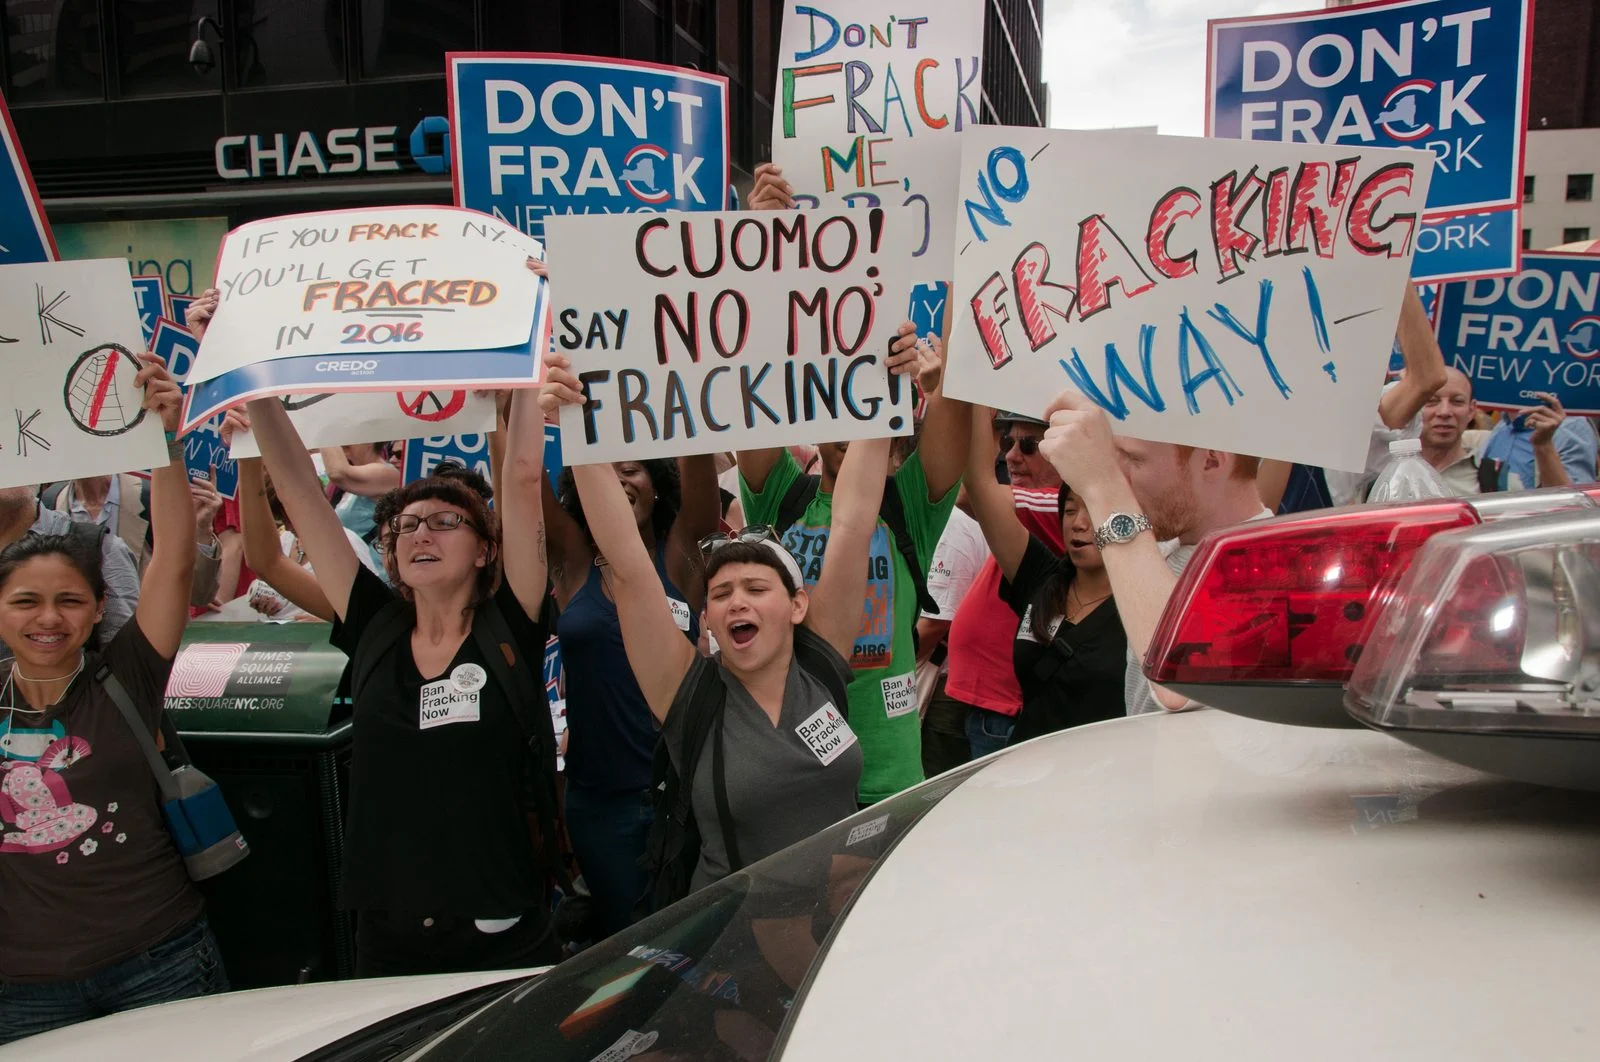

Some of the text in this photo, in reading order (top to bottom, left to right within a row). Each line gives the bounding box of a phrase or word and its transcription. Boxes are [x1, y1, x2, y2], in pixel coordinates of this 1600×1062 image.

[795, 5, 928, 61] DON'T
[1242, 7, 1491, 94] DON'T
[484, 79, 703, 145] DON'T
[782, 56, 979, 138] FRACK
[1241, 73, 1487, 145] FRACK
[215, 126, 400, 180] CHASE
[821, 135, 911, 192] ME,
[489, 144, 706, 204] FRACK
[965, 145, 1029, 243] NO
[242, 231, 279, 259] IF
[288, 227, 339, 249] YOU
[347, 222, 440, 243] FRACK
[635, 208, 885, 280] CUOMO!
[1416, 222, 1490, 253] ORK
[970, 156, 1417, 370] FRACKING
[223, 258, 428, 302] YOU'LL GET
[302, 279, 498, 312] FRACKED
[275, 321, 425, 350] IN 2016
[558, 308, 629, 351] SAY
[654, 288, 750, 365] NO
[1059, 265, 1338, 421] WAY!
[315, 360, 378, 372] CREDO
[1453, 353, 1532, 382] NEW
[578, 336, 904, 445] FRACKING!
[785, 531, 826, 556] STO
[239, 662, 293, 673] SQUARE
[252, 651, 294, 661] TIMES
[236, 675, 284, 685] ALLIANCE
[422, 685, 445, 698] Ban
[882, 680, 902, 691] Ban
[163, 697, 285, 710] IMESSQUARENYC.ORG
[422, 693, 478, 709] Fracking
[422, 707, 449, 721] Now
[886, 699, 908, 711] Now
[799, 717, 824, 739] Ban
[807, 716, 846, 748] Fracking
[815, 735, 841, 758] Now
